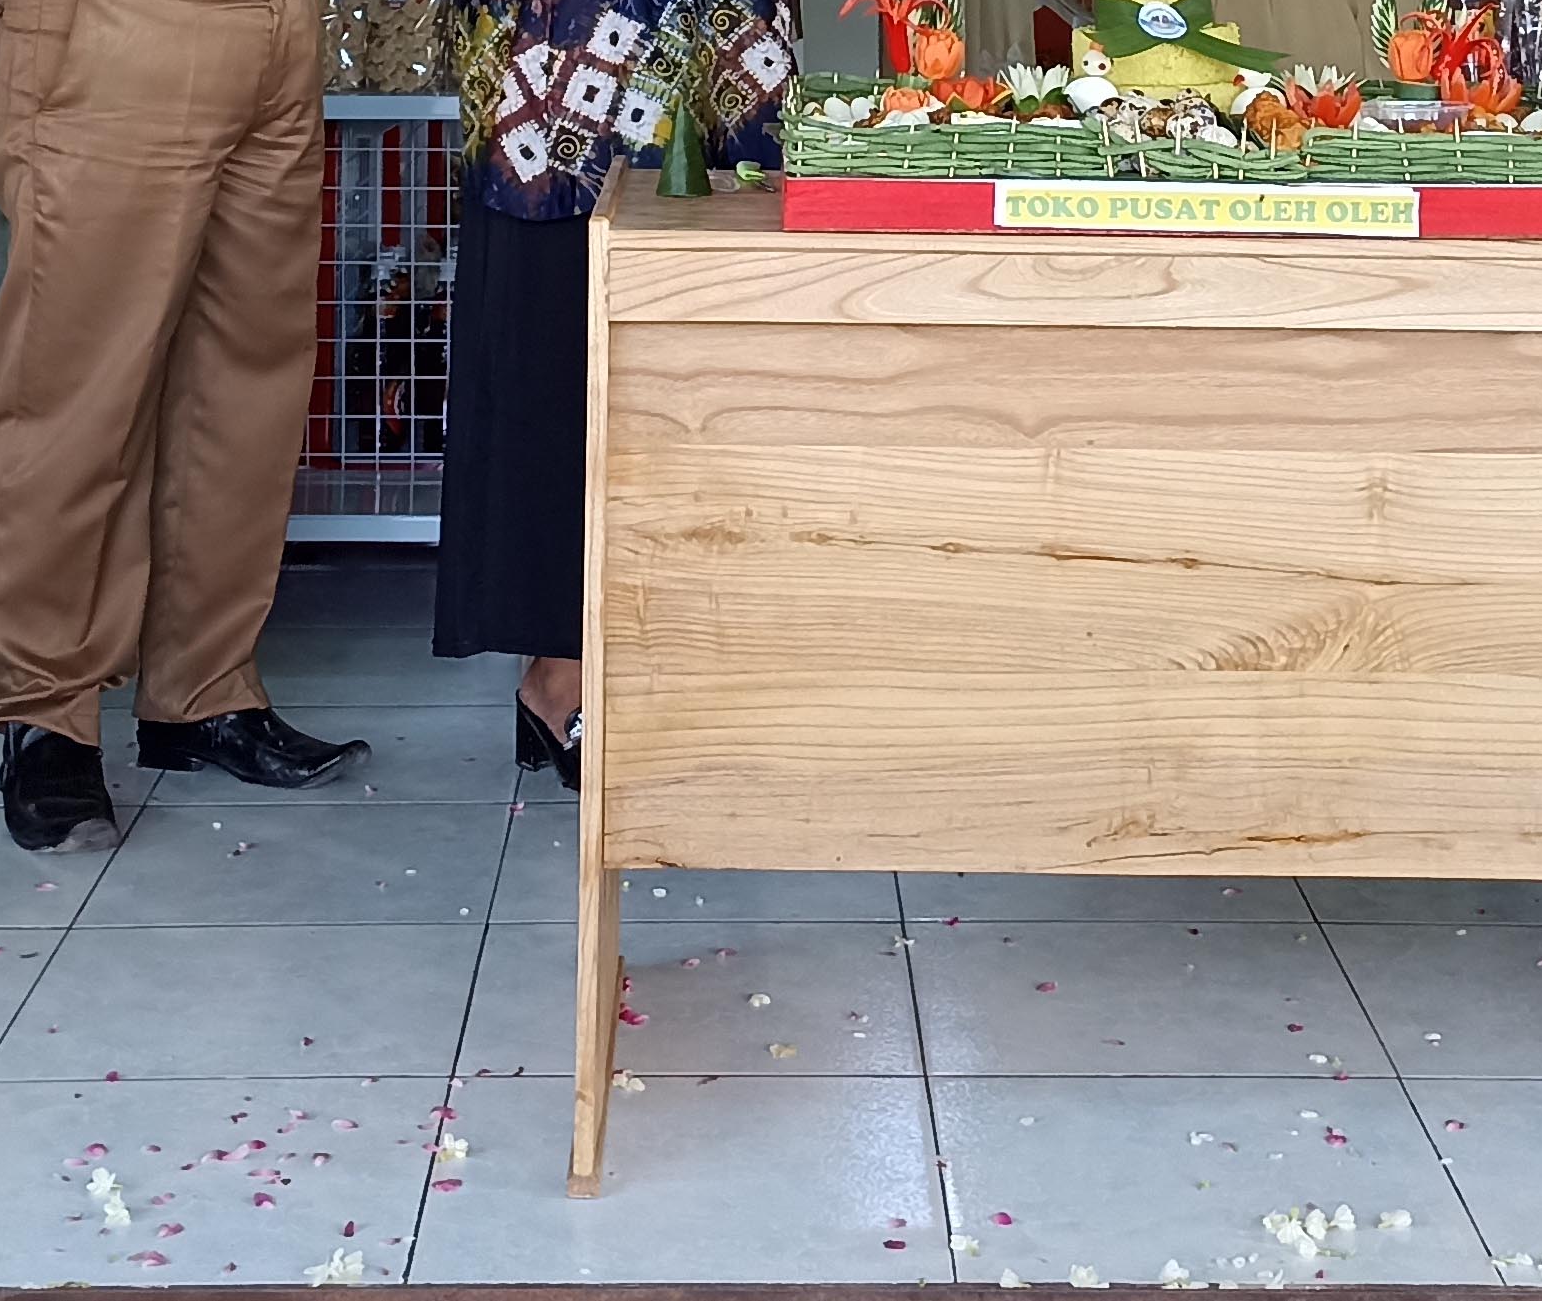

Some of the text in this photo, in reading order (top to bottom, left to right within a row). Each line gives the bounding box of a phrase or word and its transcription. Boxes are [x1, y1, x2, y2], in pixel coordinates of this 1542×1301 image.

[1006, 195, 1414, 224] TOKO PUSAT OLEH OLEH
